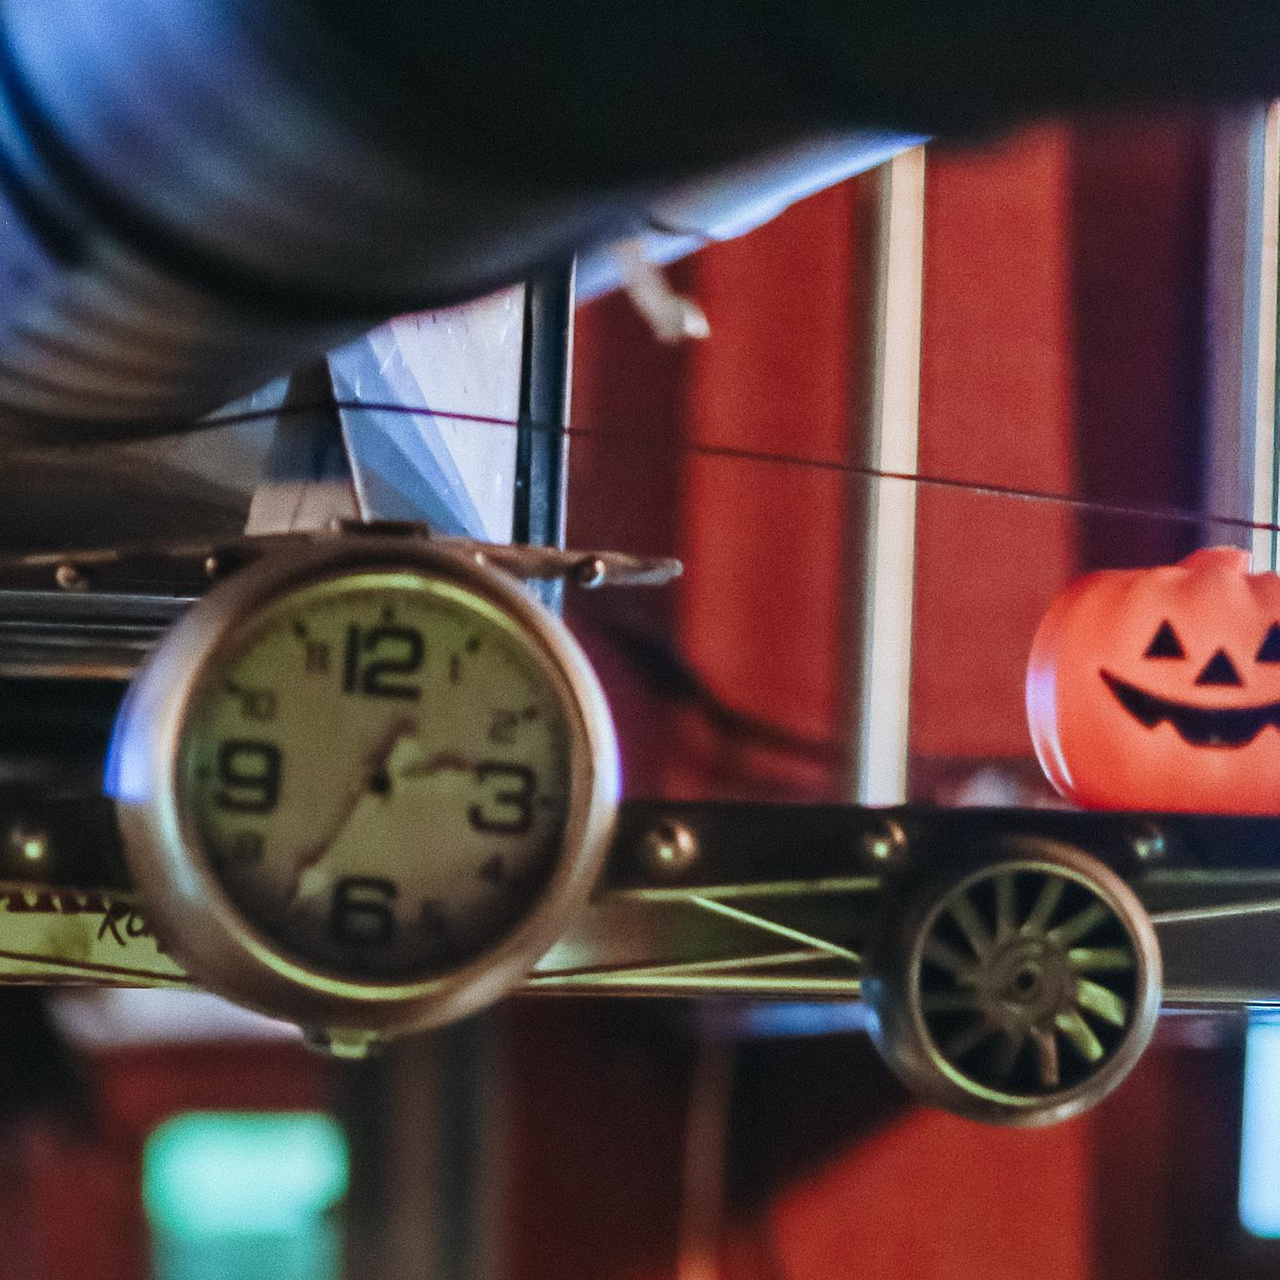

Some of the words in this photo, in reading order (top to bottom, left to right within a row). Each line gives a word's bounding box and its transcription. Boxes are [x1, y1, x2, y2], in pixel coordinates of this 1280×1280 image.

[343, 623, 421, 698] 12
[219, 740, 282, 813] 9
[468, 761, 537, 835] 3
[332, 876, 397, 943] 6
